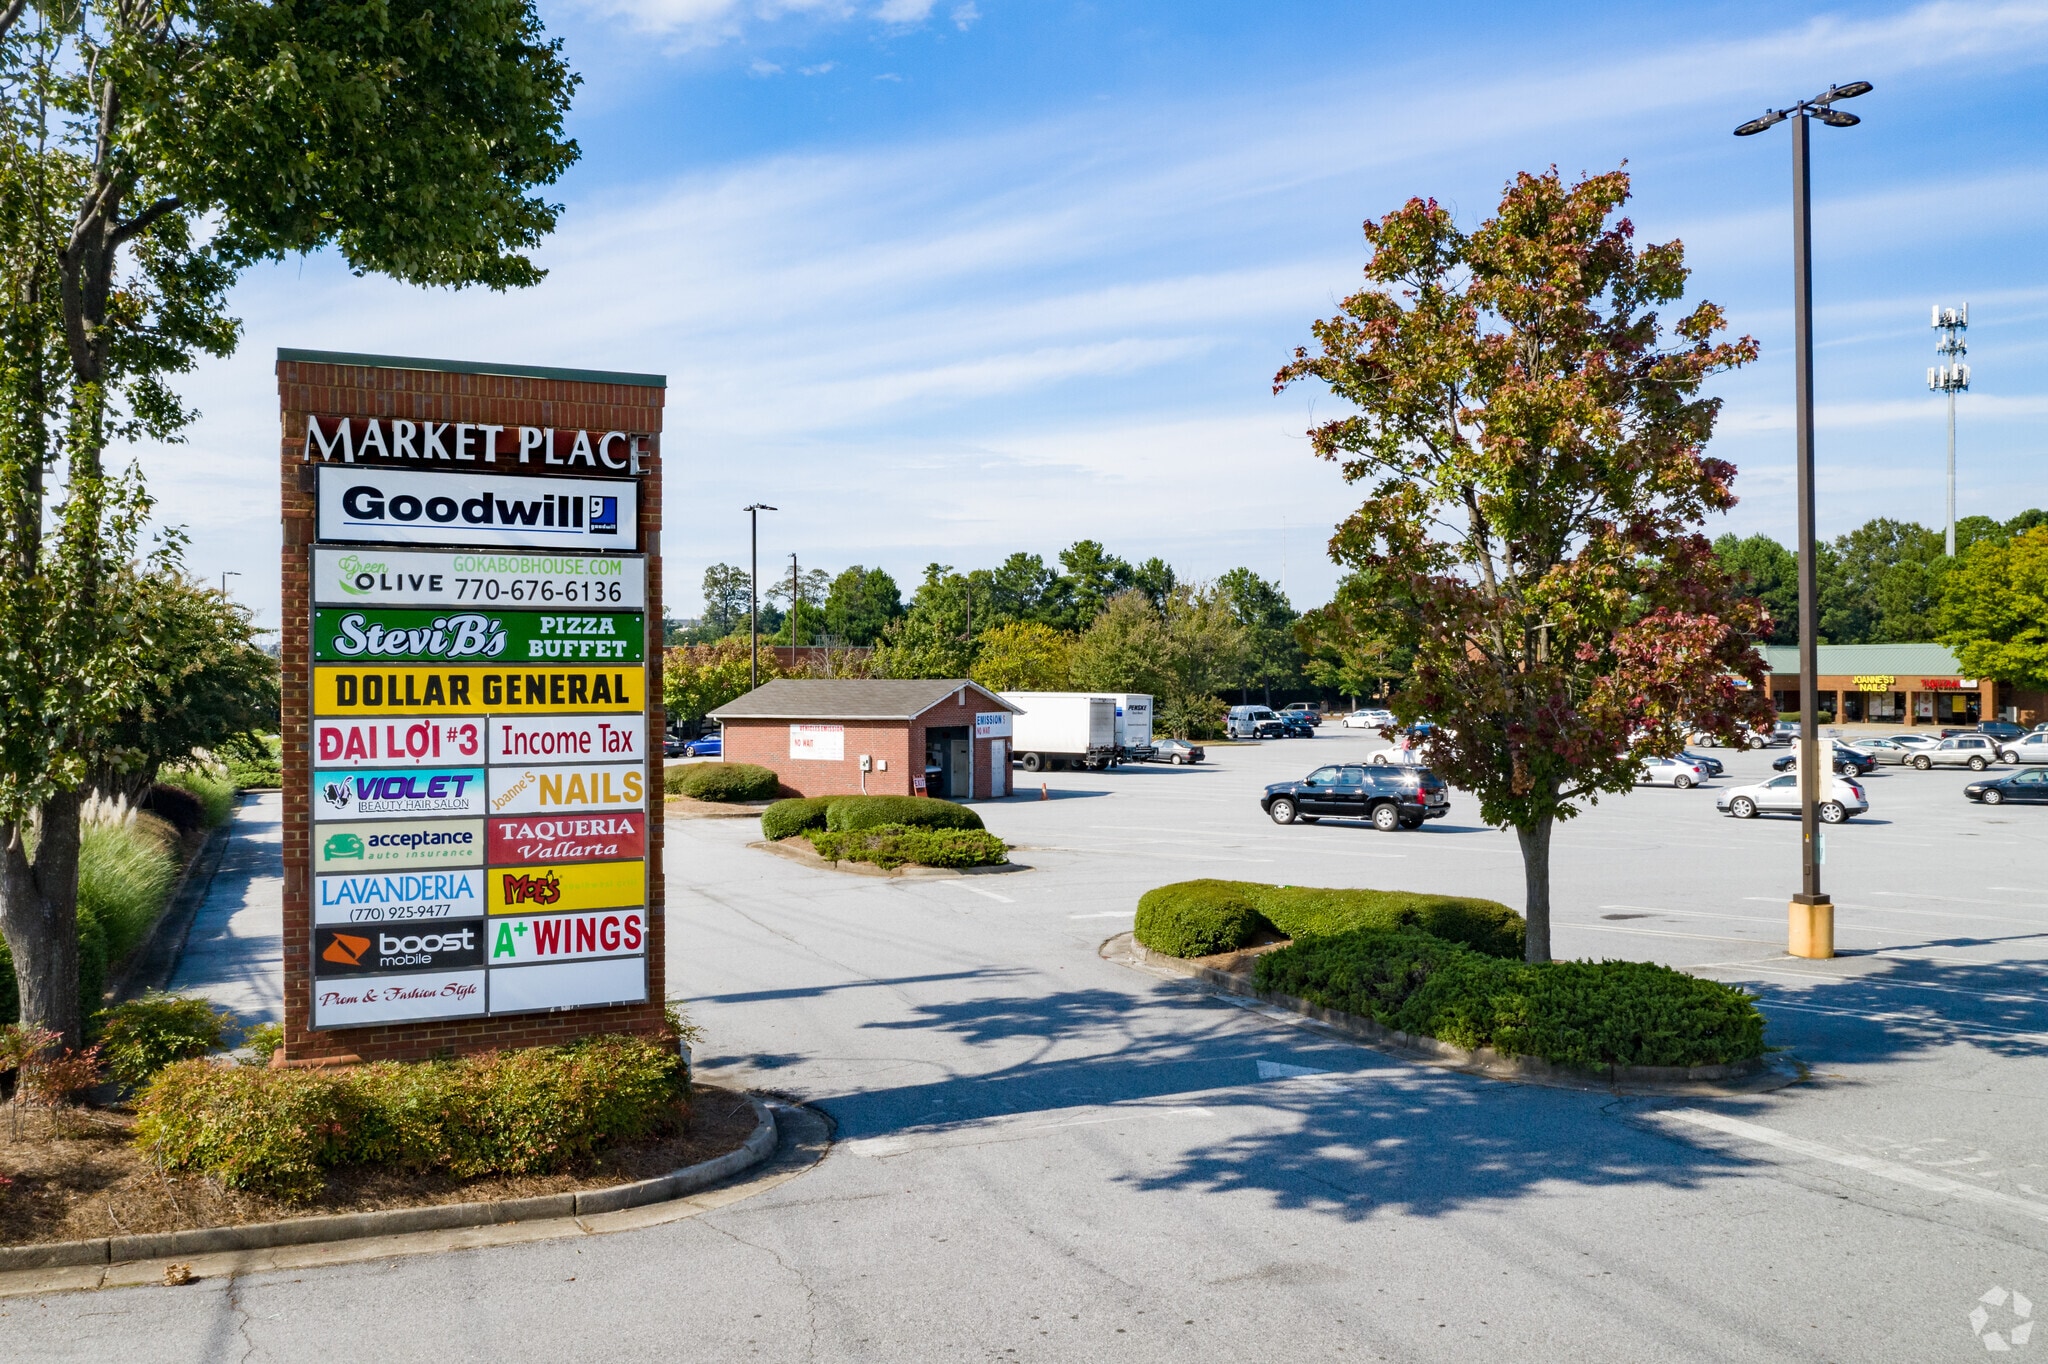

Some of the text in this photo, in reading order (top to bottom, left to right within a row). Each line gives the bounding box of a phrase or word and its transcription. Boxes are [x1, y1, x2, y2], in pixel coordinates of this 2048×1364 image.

[303, 414, 504, 463] MARKET
[342, 485, 584, 529] Goodwill
[338, 554, 389, 580] Green
[453, 555, 622, 576] GOKABOBHOUSE.COM
[355, 572, 444, 592] OLIVE
[454, 578, 622, 602] 770-676-6136
[540, 616, 616, 635] PIZZA
[528, 639, 627, 658] BUFFET
[335, 673, 630, 707] DOLLAR GENERAL
[1859, 683, 1888, 692] NAILS
[446, 723, 479, 756] #3
[501, 723, 634, 756] Income Tax
[356, 775, 474, 801] VIOLET
[539, 771, 644, 806] NAILS
[359, 798, 470, 812] BEAUTY HAIR SALON
[368, 831, 473, 850] acceptance
[498, 818, 636, 841] TAQUERIA
[368, 849, 473, 860] auto insurance
[517, 841, 618, 859] Vallarta
[321, 874, 474, 906] LAVANDERIA
[350, 904, 451, 922] (770) 925-9477
[379, 928, 475, 955] boost
[493, 915, 642, 958] A+ WINGS
[380, 953, 432, 967] mobile
[319, 982, 477, 1007] Prom & Fashion Style
